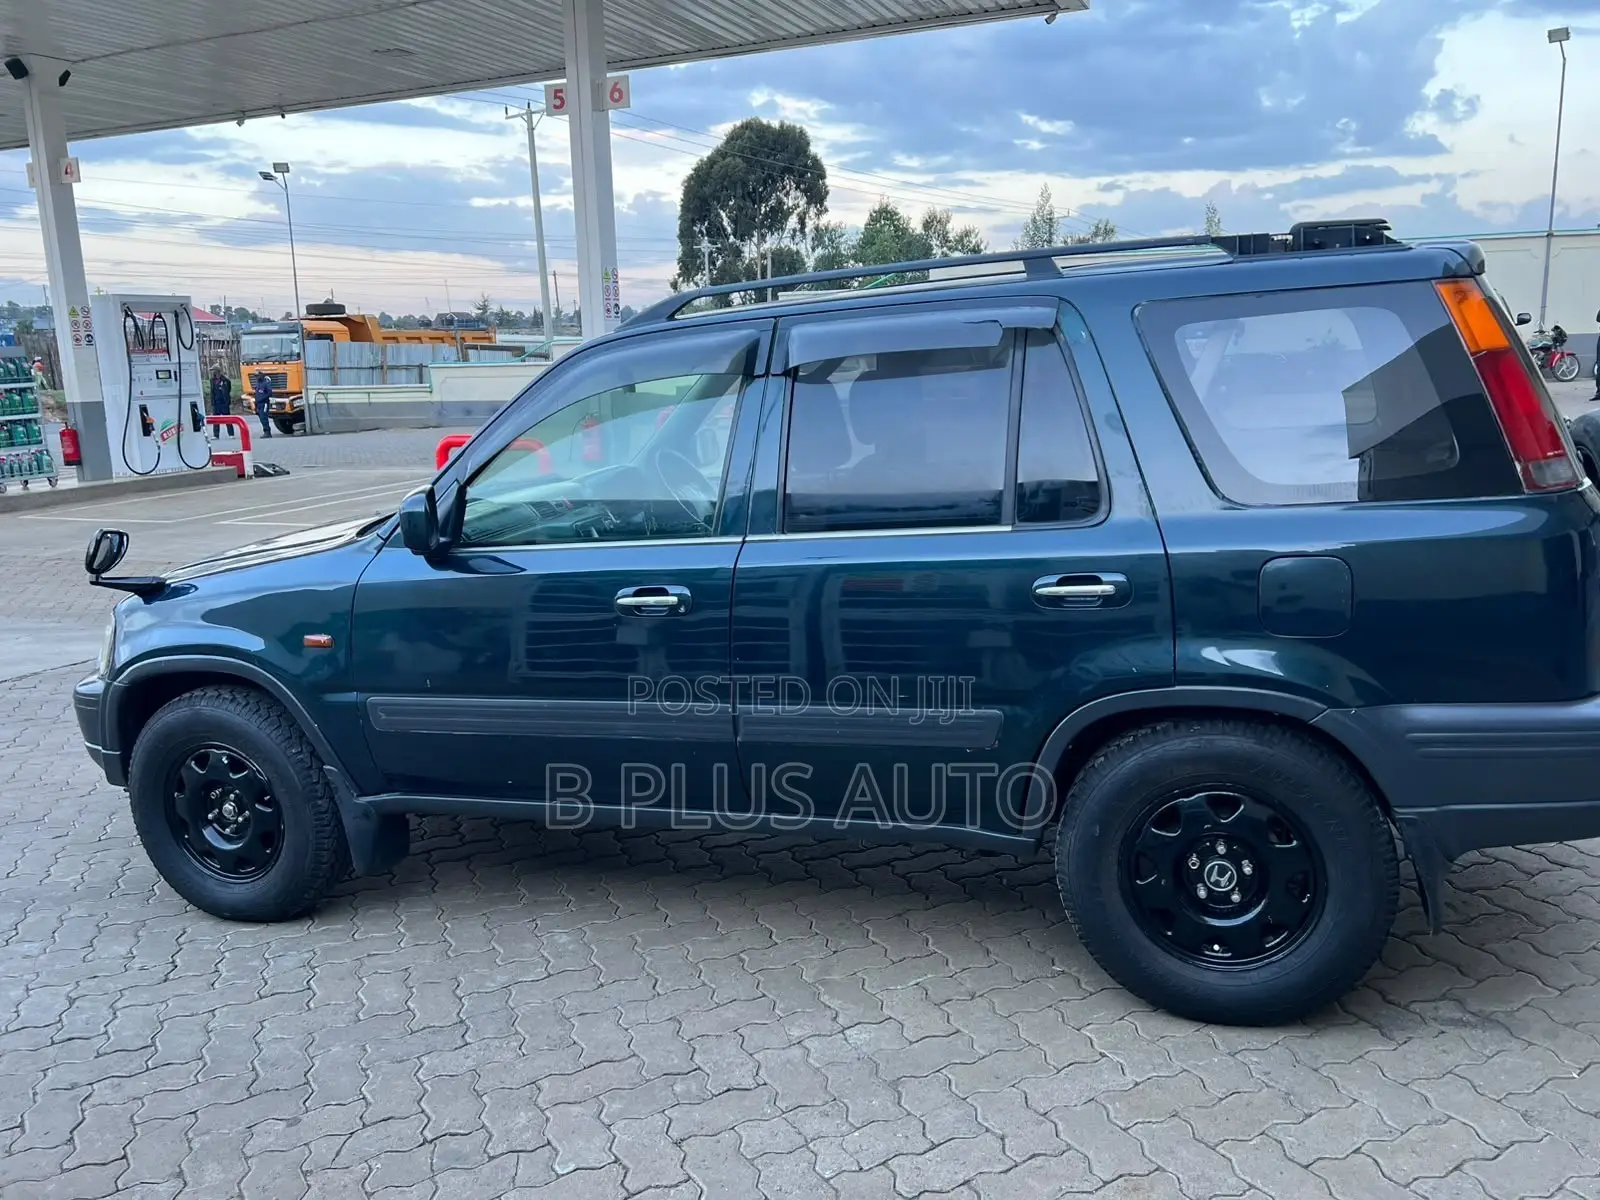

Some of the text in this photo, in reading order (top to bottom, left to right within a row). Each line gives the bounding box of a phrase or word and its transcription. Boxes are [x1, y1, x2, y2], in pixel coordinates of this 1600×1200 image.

[552, 88, 566, 110] 5
[609, 81, 624, 103] 6
[64, 161, 75, 179] 4
[161, 425, 184, 440] RUB
